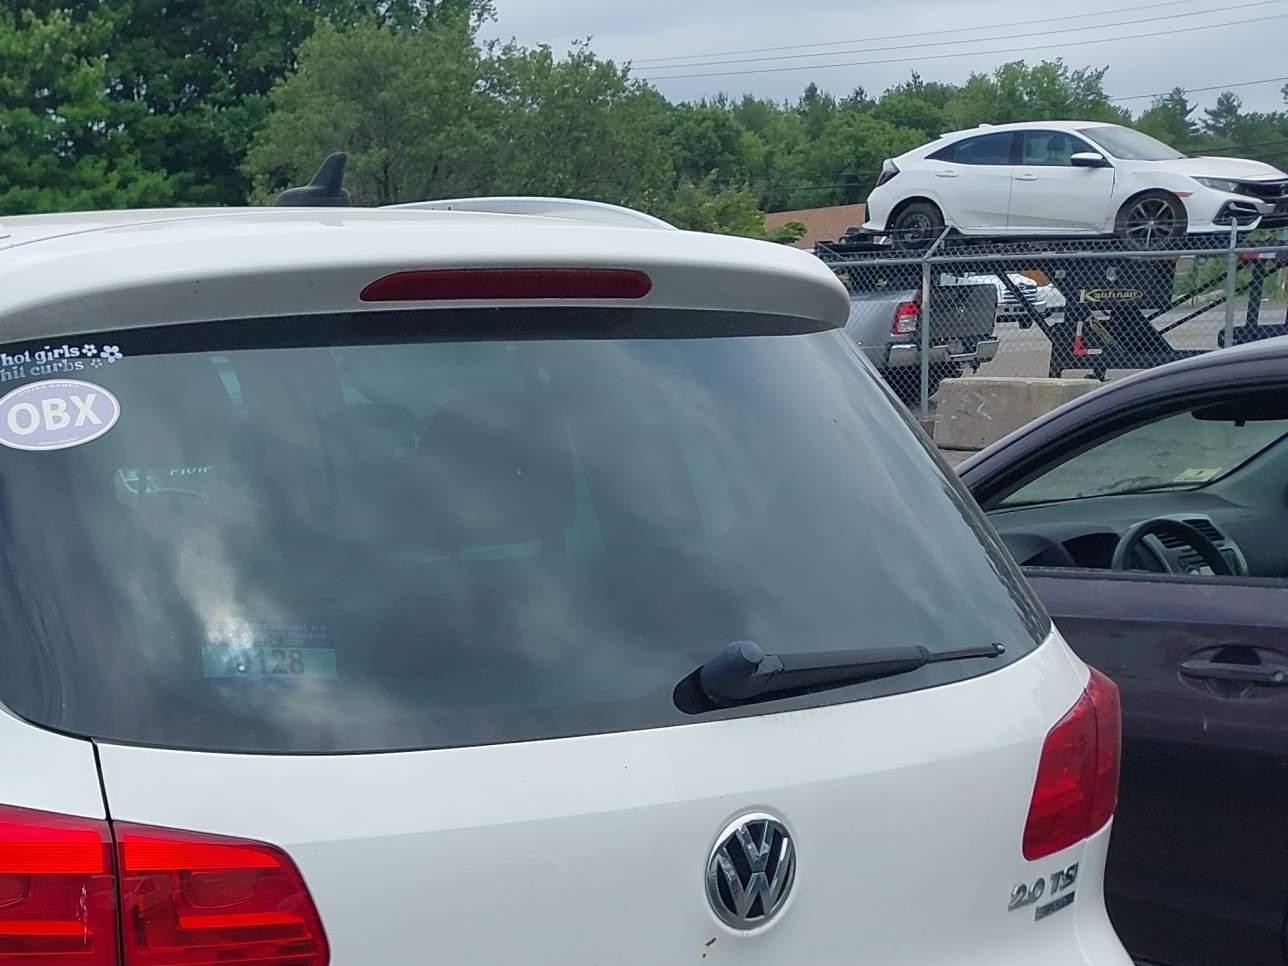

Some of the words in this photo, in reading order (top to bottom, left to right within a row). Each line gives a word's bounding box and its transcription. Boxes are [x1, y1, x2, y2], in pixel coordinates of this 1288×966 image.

[0, 350, 32, 367] hot
[34, 345, 81, 364] girls
[0, 366, 28, 382] hit
[30, 358, 85, 376] curbs
[7, 393, 103, 437] OBX
